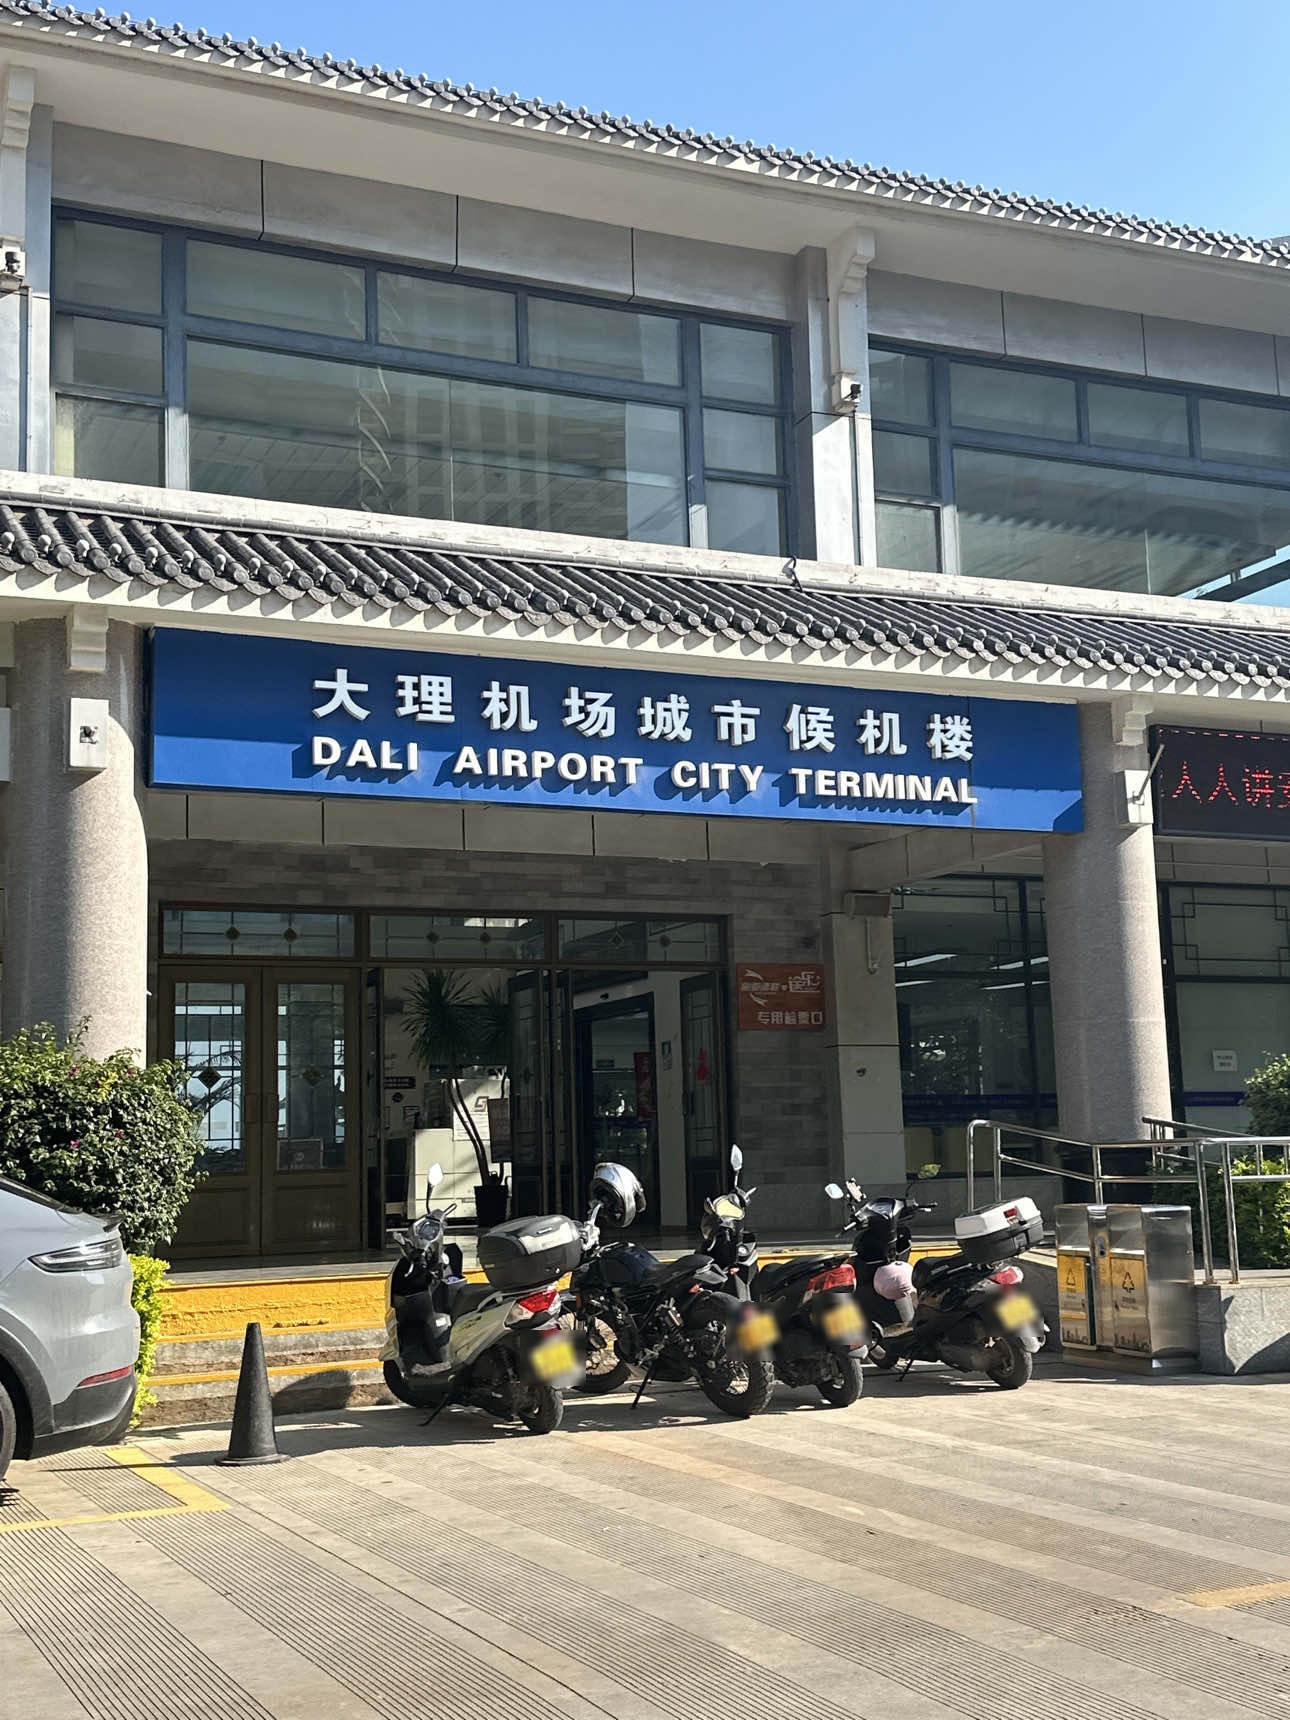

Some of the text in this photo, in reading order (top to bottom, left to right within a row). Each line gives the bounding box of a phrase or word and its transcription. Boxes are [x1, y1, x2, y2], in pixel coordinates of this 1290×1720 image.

[312, 668, 974, 761] 大理机场城市候机楼
[312, 736, 978, 804] DALI AIRPORT CITY TERMINAL
